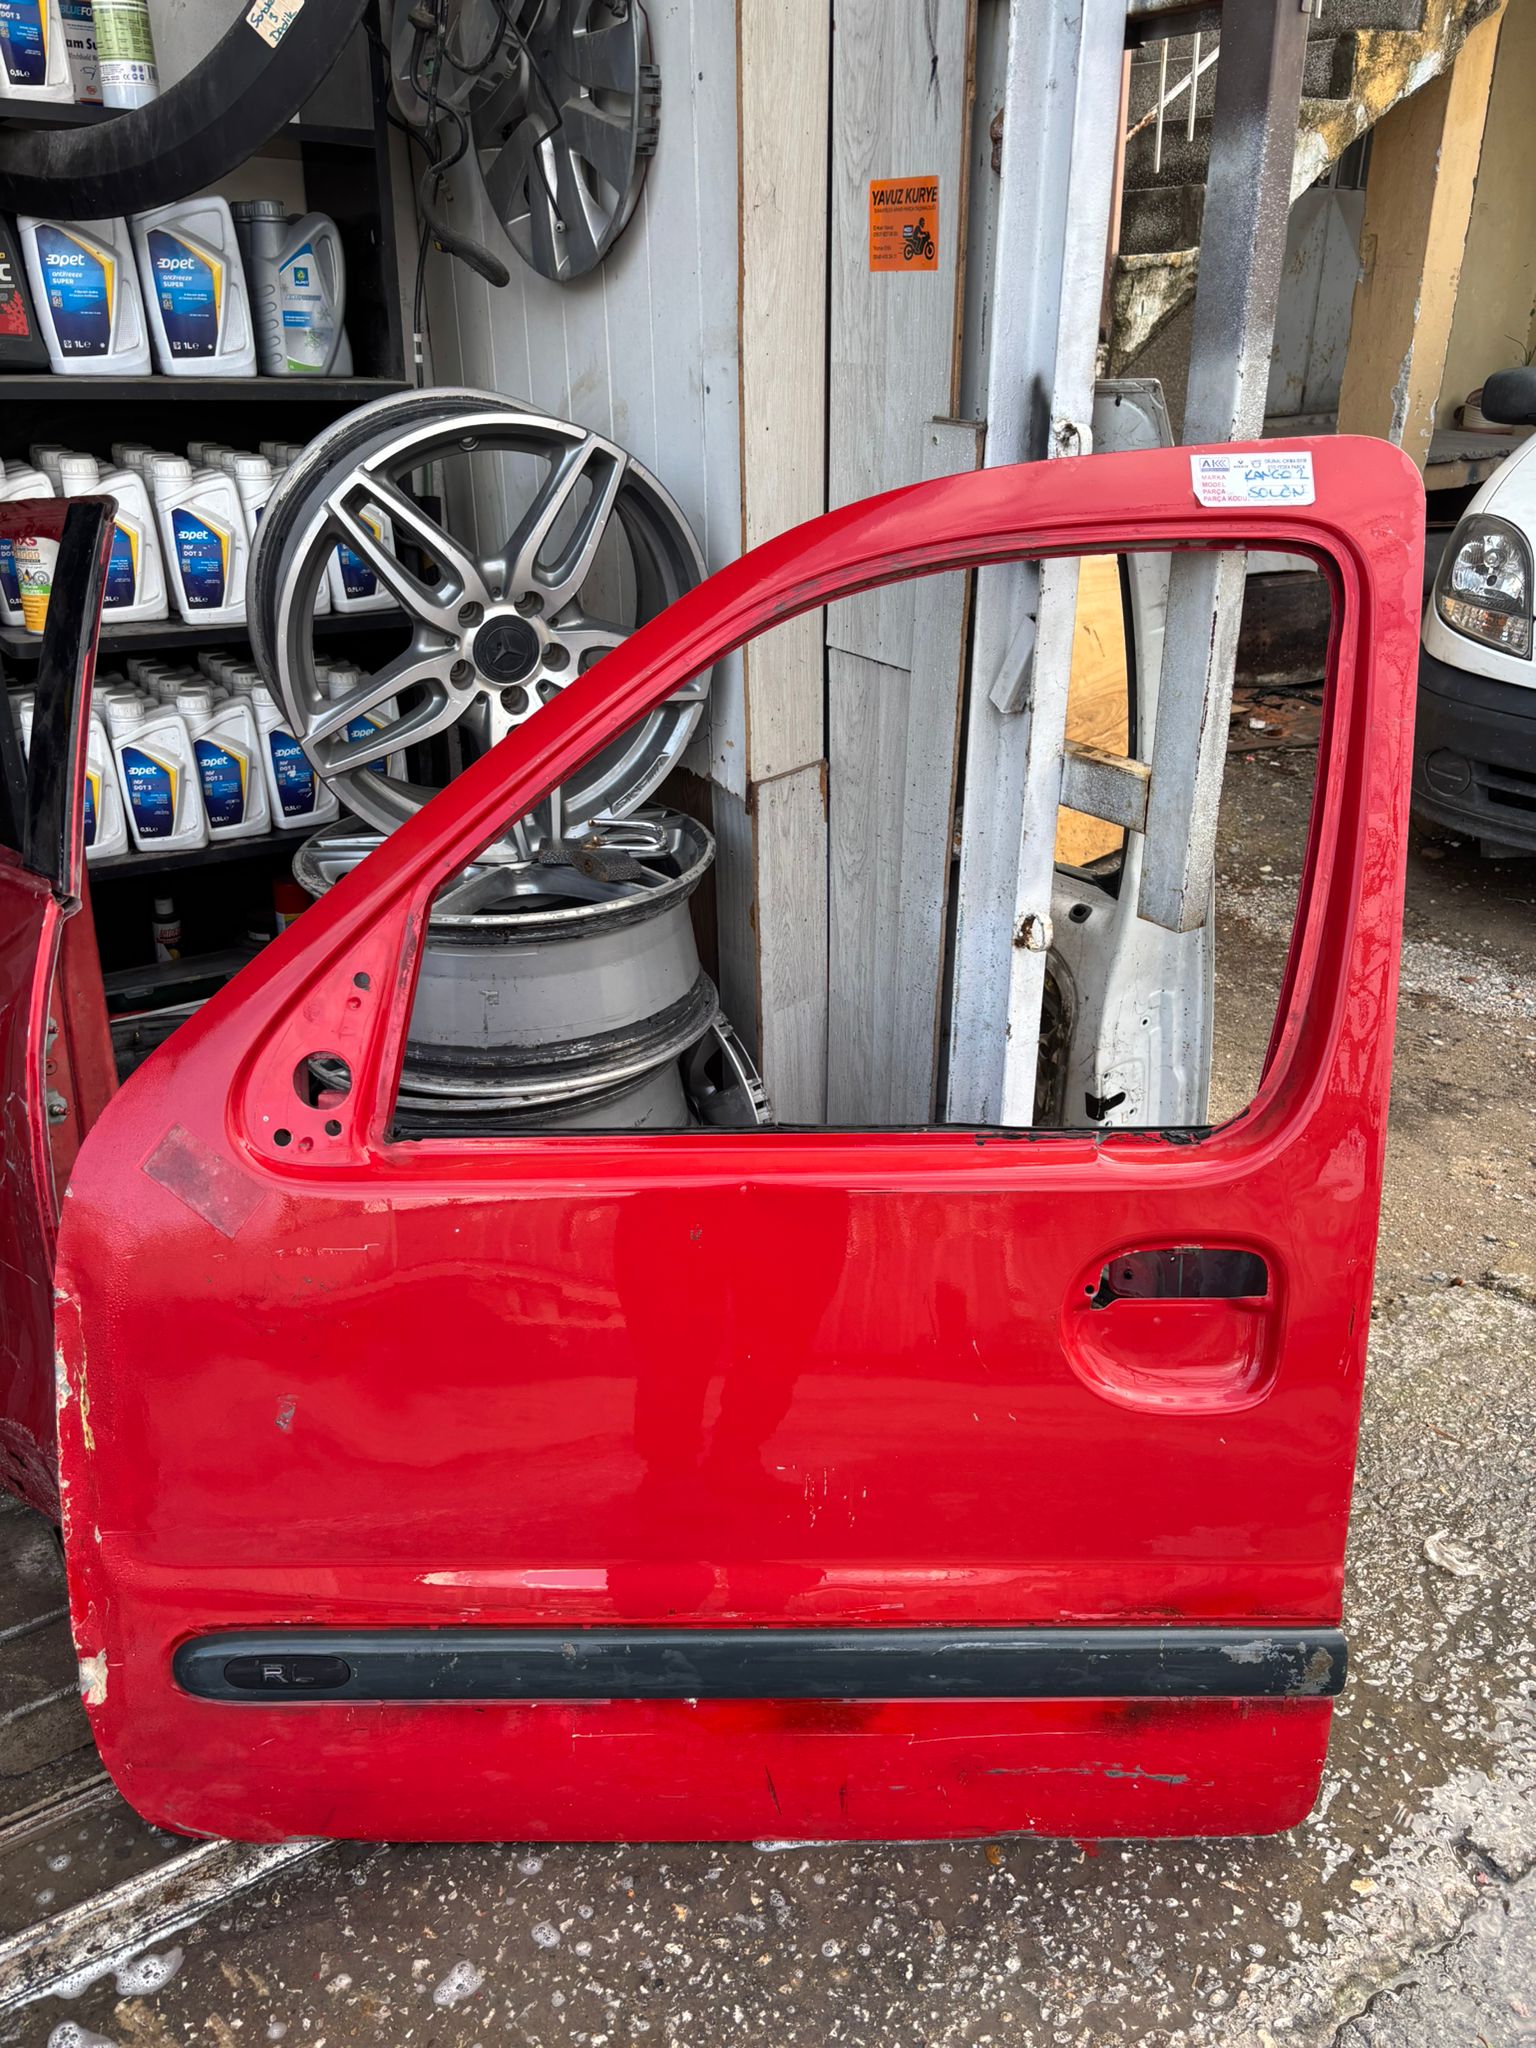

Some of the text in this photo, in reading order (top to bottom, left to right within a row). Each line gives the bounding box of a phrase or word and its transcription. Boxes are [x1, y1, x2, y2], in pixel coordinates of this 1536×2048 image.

[872, 186, 938, 206] YAVUZ KURYE
[45, 253, 86, 267] opet
[156, 258, 196, 271] opet
[178, 530, 209, 541] opet
[200, 757, 229, 767] opet
[128, 766, 158, 776] opet
